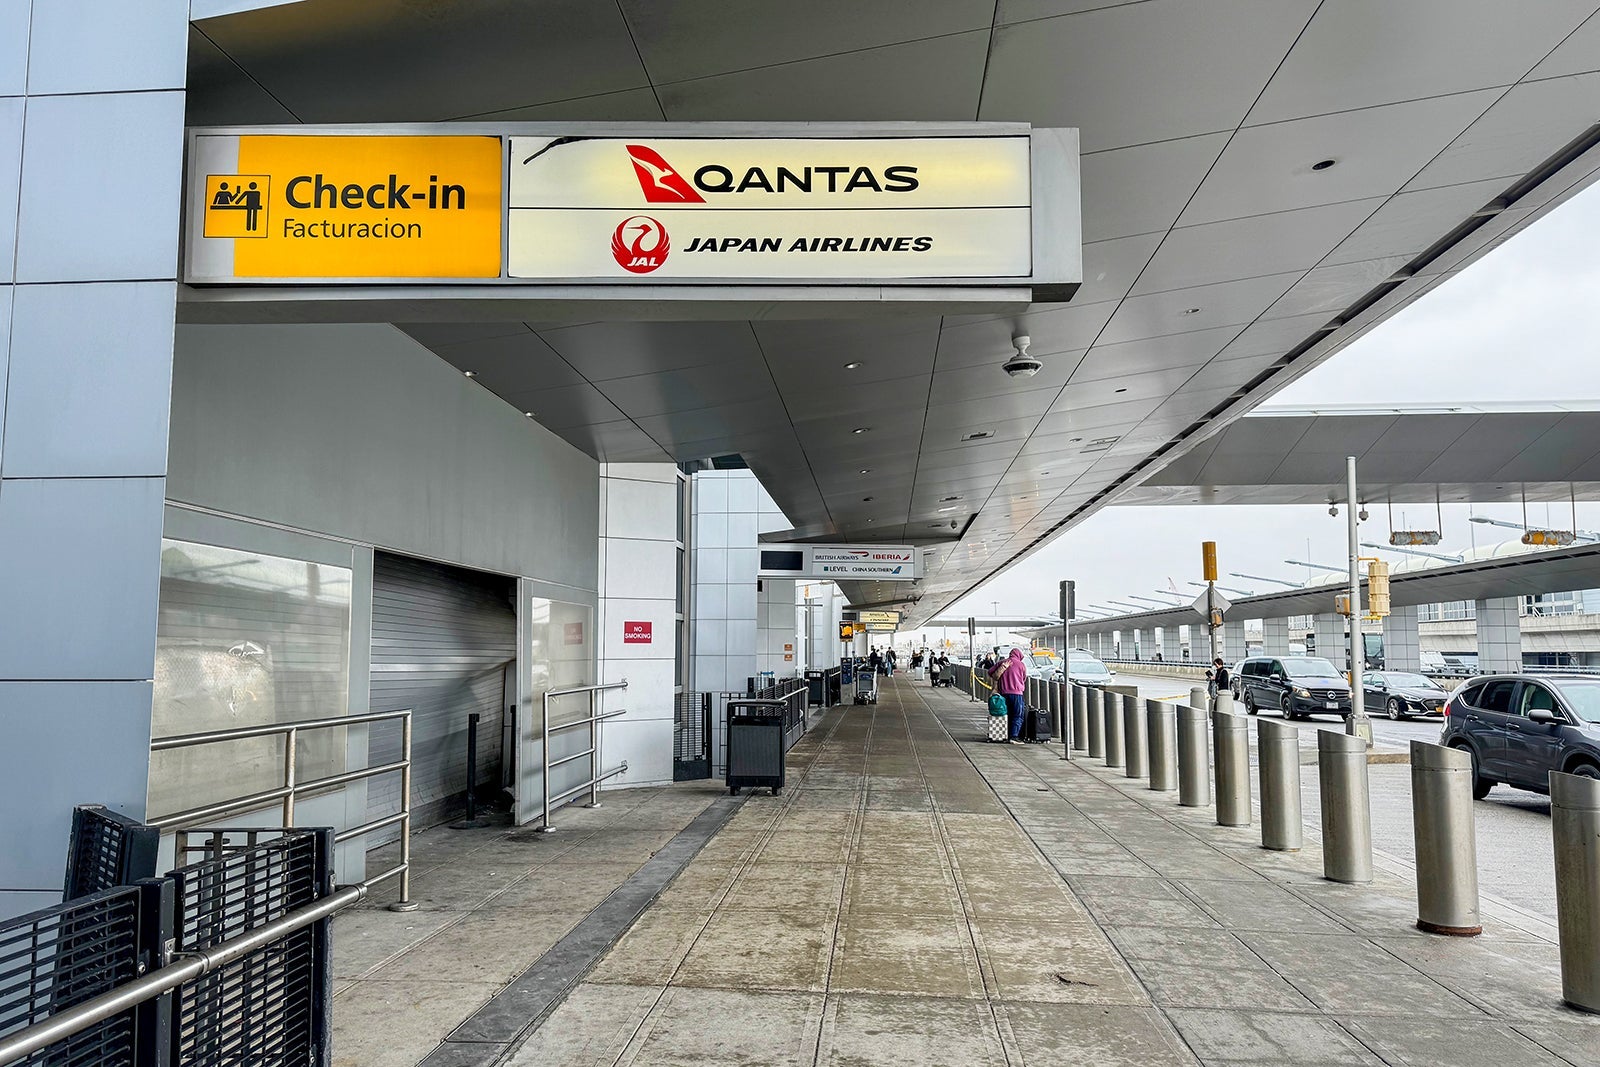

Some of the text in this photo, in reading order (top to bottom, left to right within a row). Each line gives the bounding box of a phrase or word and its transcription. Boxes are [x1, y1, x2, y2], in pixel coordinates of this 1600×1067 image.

[693, 164, 920, 193] QANTAS
[285, 173, 466, 210] Check-in
[283, 217, 422, 239] Facturacion
[683, 236, 934, 253] JAPAN AIRLINES
[627, 256, 659, 267] JAL
